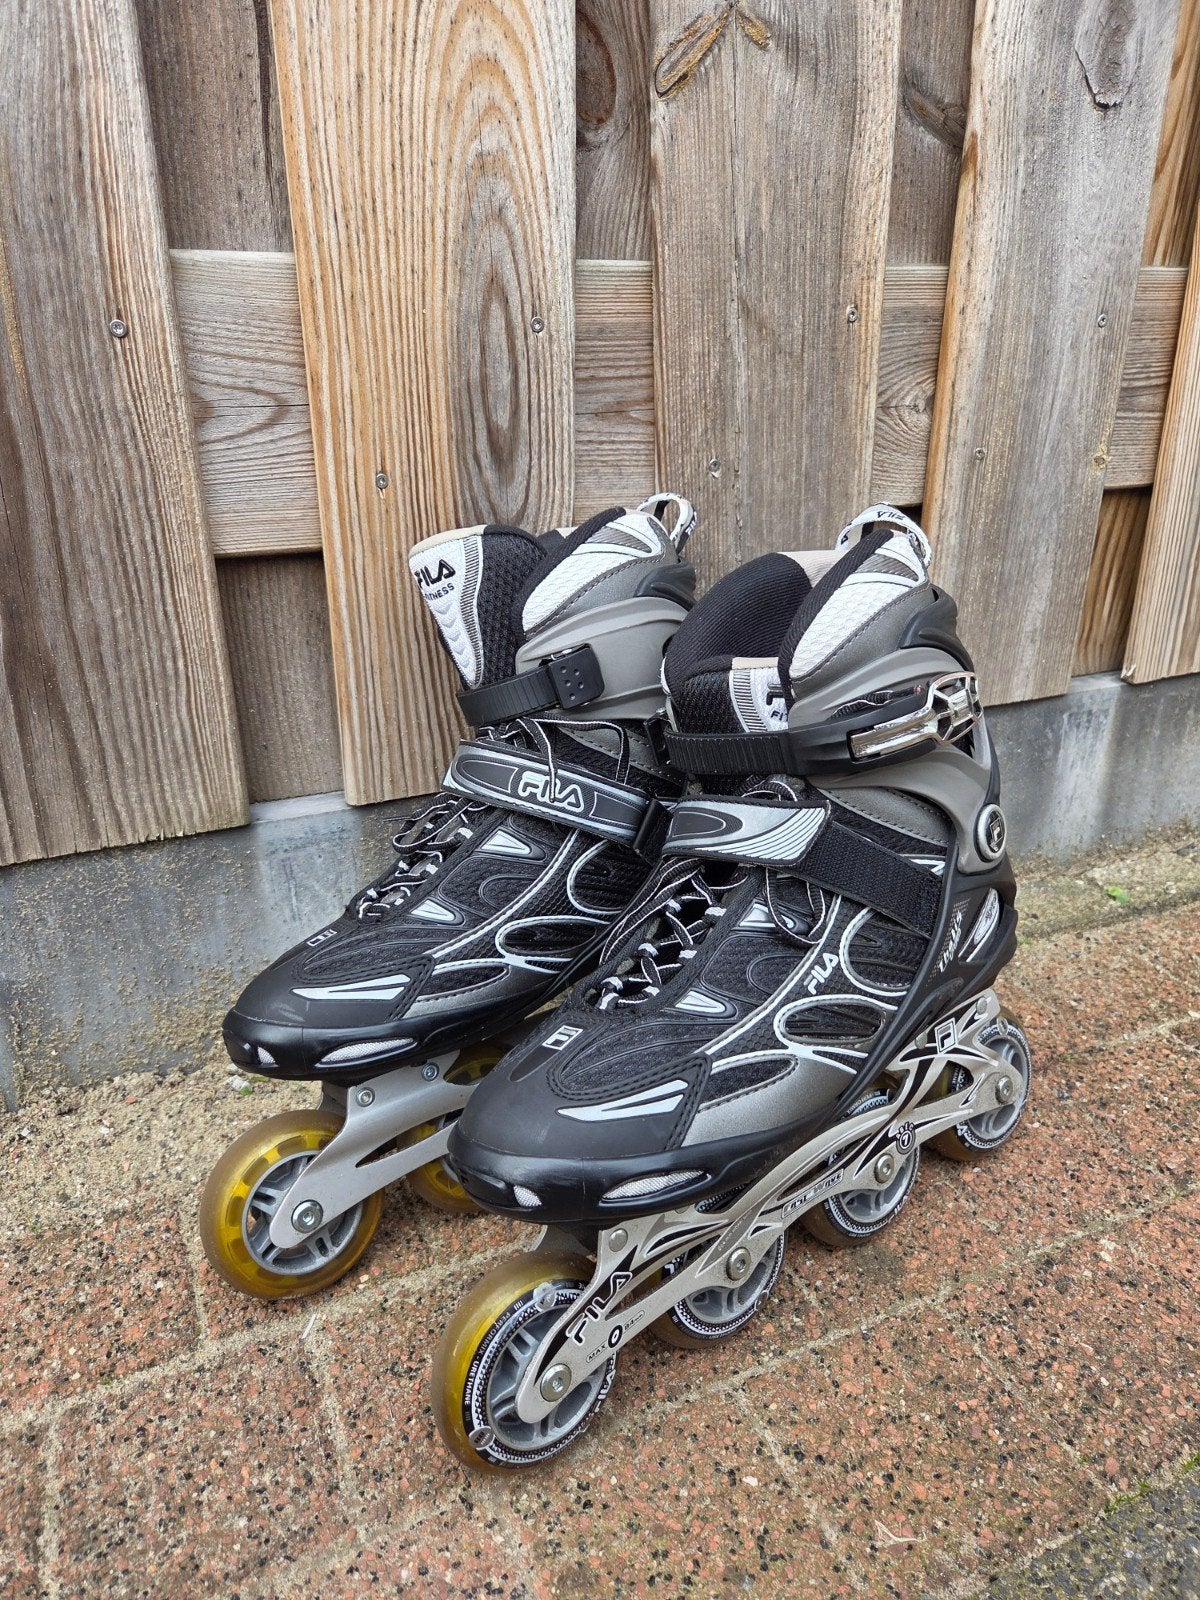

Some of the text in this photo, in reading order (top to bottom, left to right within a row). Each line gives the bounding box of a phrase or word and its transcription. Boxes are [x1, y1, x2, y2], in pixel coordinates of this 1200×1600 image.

[518, 771, 585, 813] FILA
[803, 953, 840, 995] FILA
[565, 1273, 633, 1346] FILA
[588, 1344, 606, 1360] MAX
[464, 1360, 480, 1406] URETHANE
